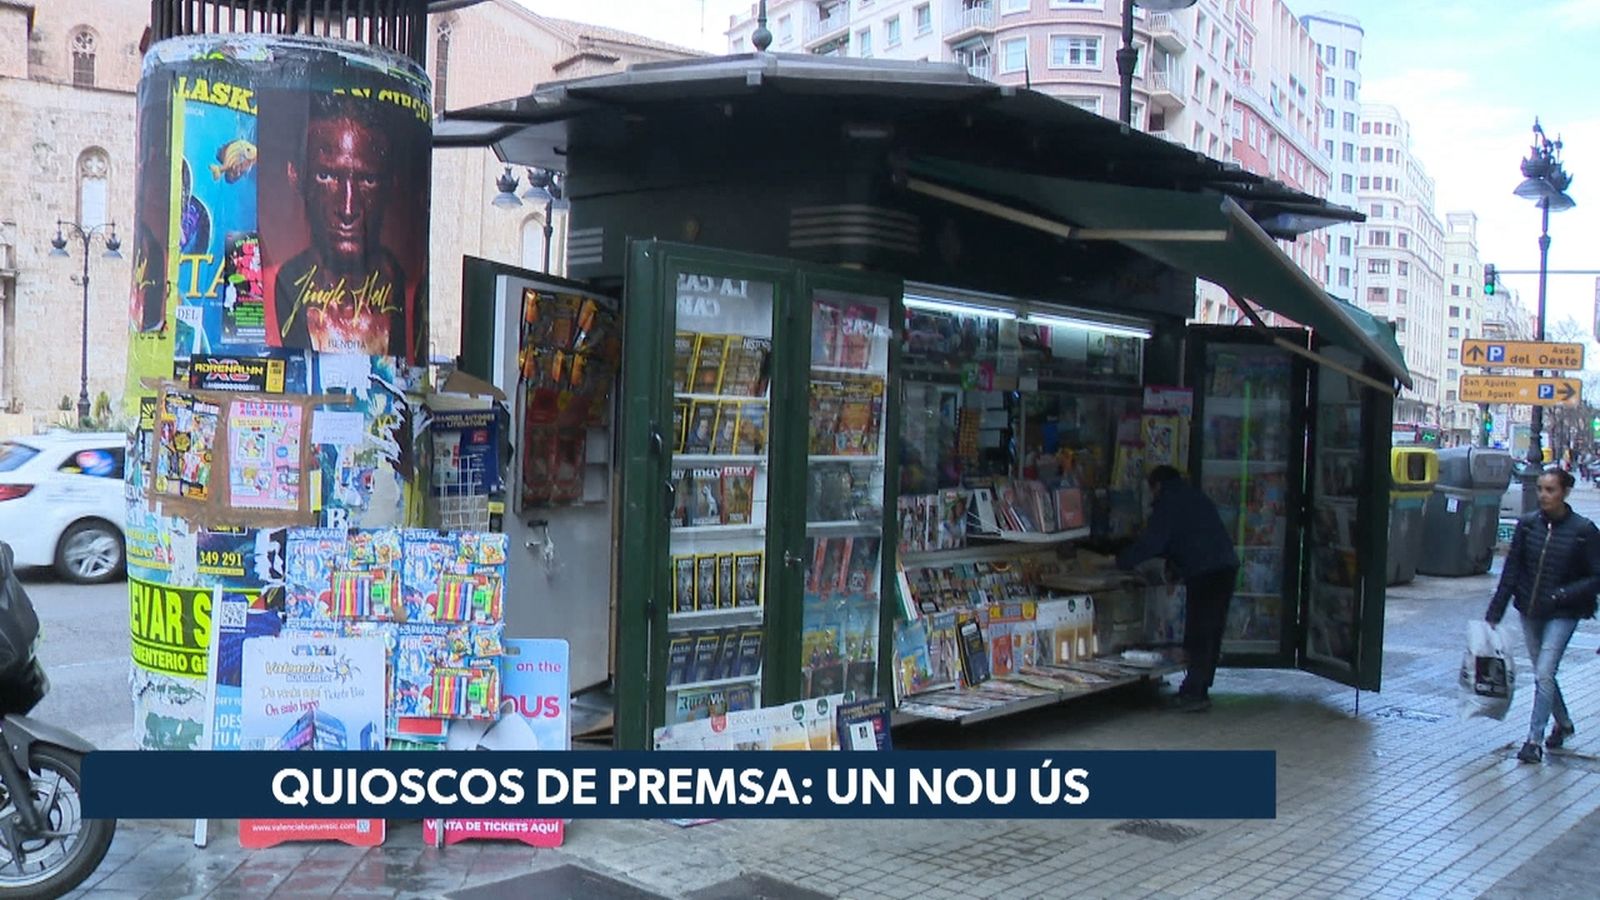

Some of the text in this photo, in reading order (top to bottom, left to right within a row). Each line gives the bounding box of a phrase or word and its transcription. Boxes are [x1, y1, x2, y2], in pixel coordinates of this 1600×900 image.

[174, 76, 258, 116] LASK
[1489, 346, 1502, 362] P
[1509, 354, 1578, 366] del Oeste
[1540, 385, 1551, 398] P
[221, 552, 242, 567] 291
[131, 581, 184, 645] EVAR
[516, 661, 561, 672] on the
[427, 820, 559, 833] VNTA DE TICKETS AQUÍ
